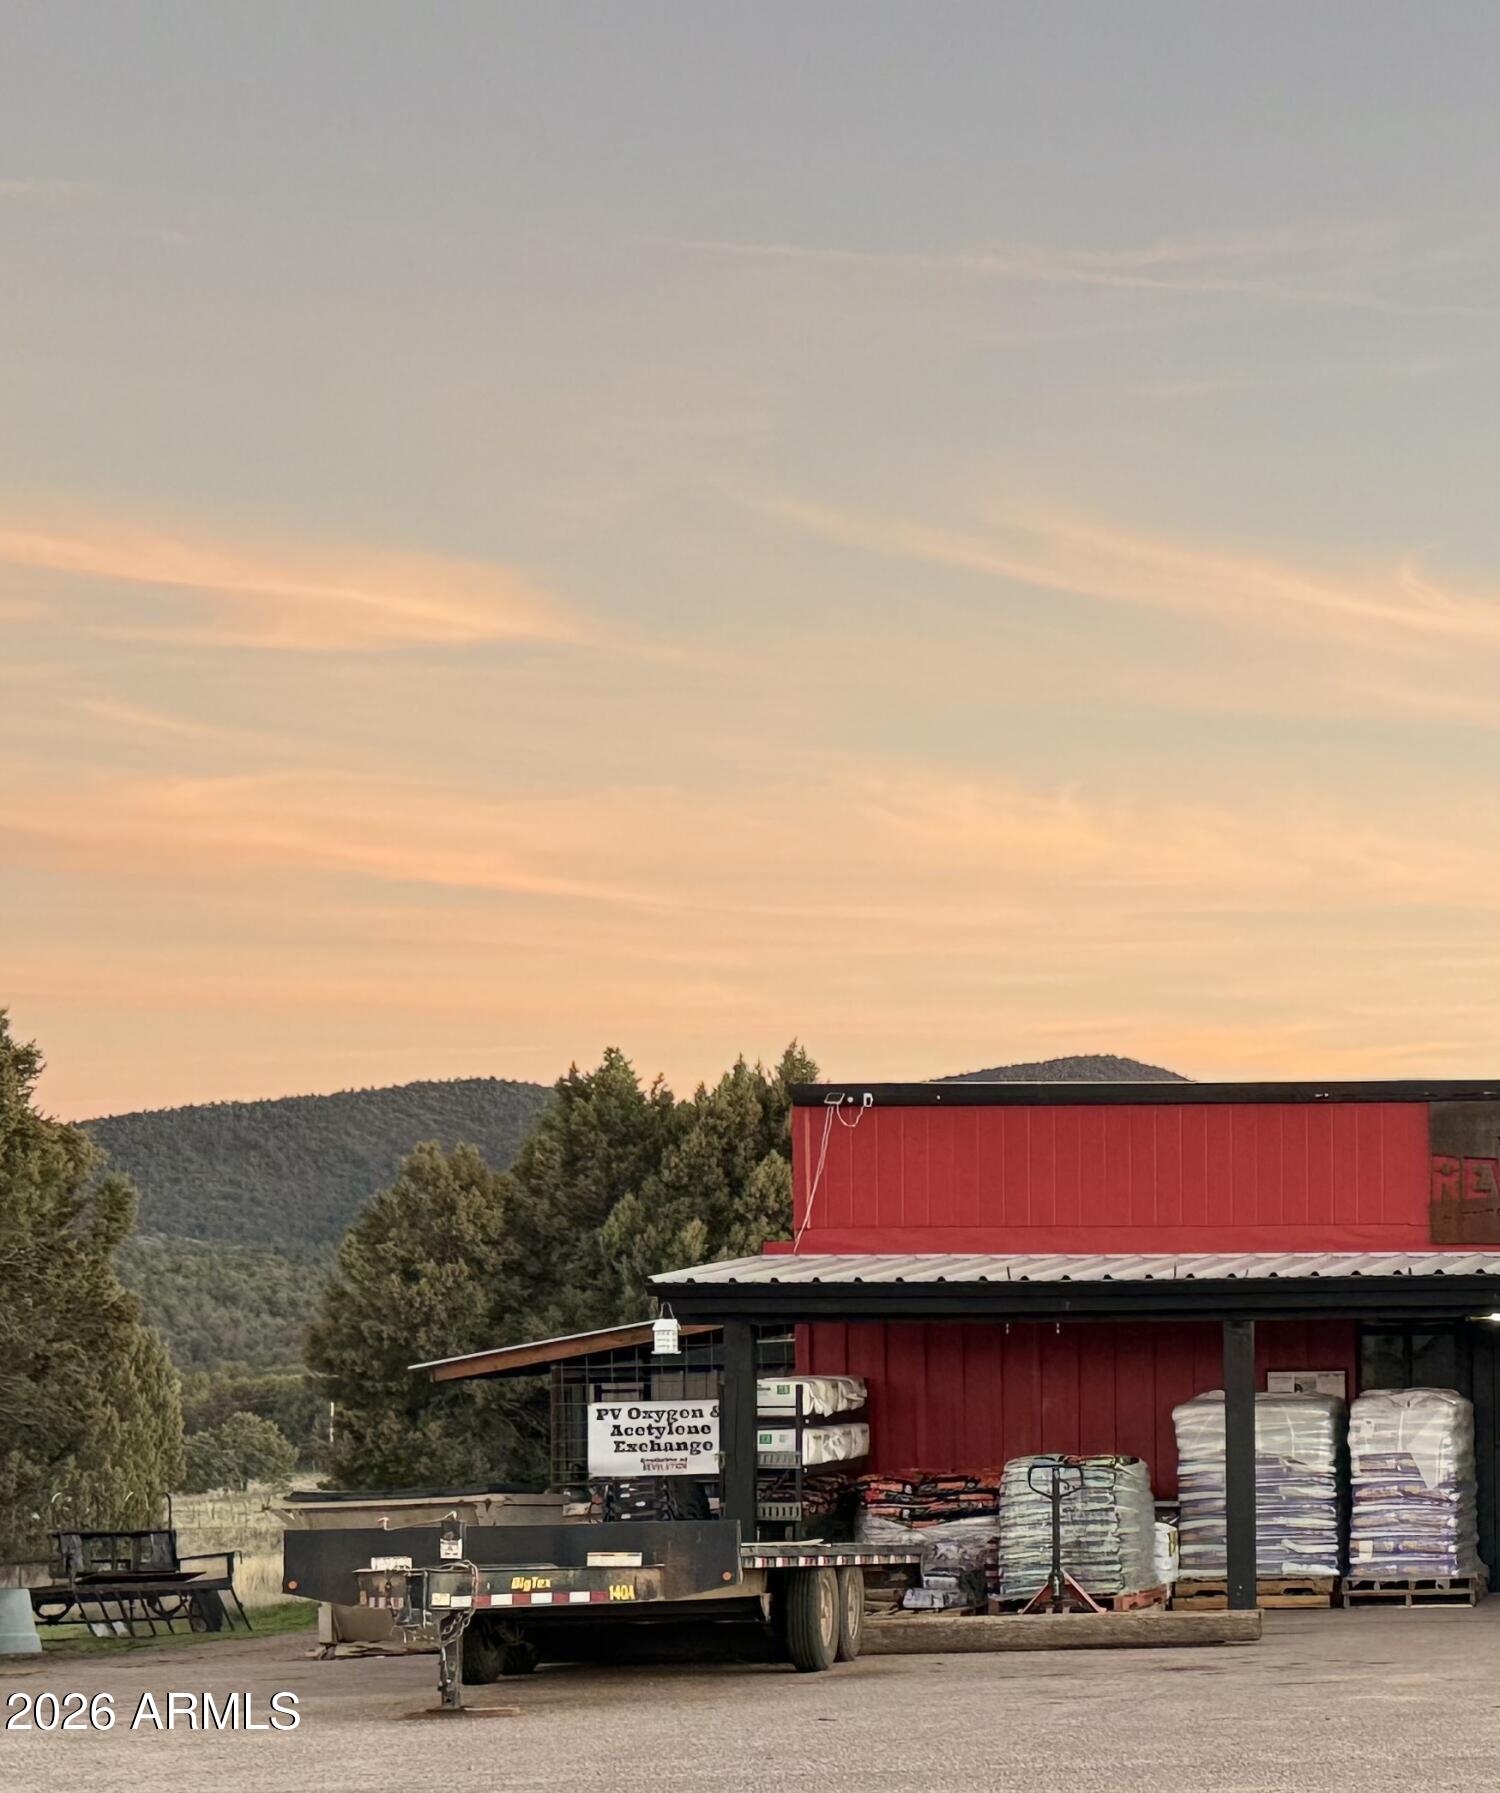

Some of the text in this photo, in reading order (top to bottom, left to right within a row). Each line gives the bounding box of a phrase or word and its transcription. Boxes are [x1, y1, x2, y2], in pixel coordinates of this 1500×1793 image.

[596, 1405, 720, 1423] PV Oxygen &
[610, 1424, 712, 1439] Acetylene
[613, 1440, 714, 1455] Exchange
